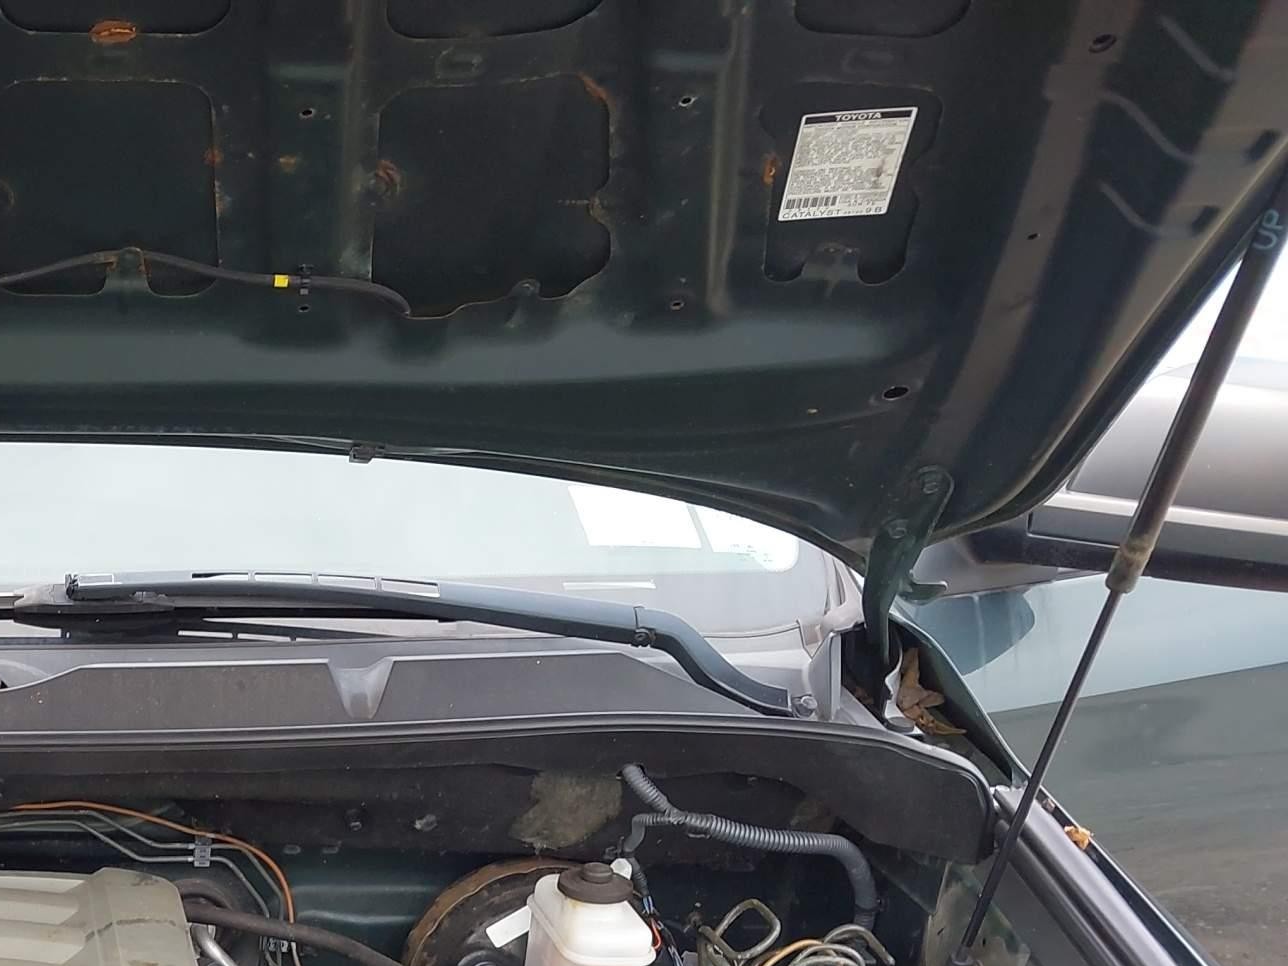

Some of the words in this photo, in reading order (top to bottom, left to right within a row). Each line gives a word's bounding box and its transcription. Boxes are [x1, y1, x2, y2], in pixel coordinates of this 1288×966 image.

[834, 112, 882, 121] TOYOTA
[782, 209, 840, 219] CATALYST
[1253, 209, 1283, 249] UP
